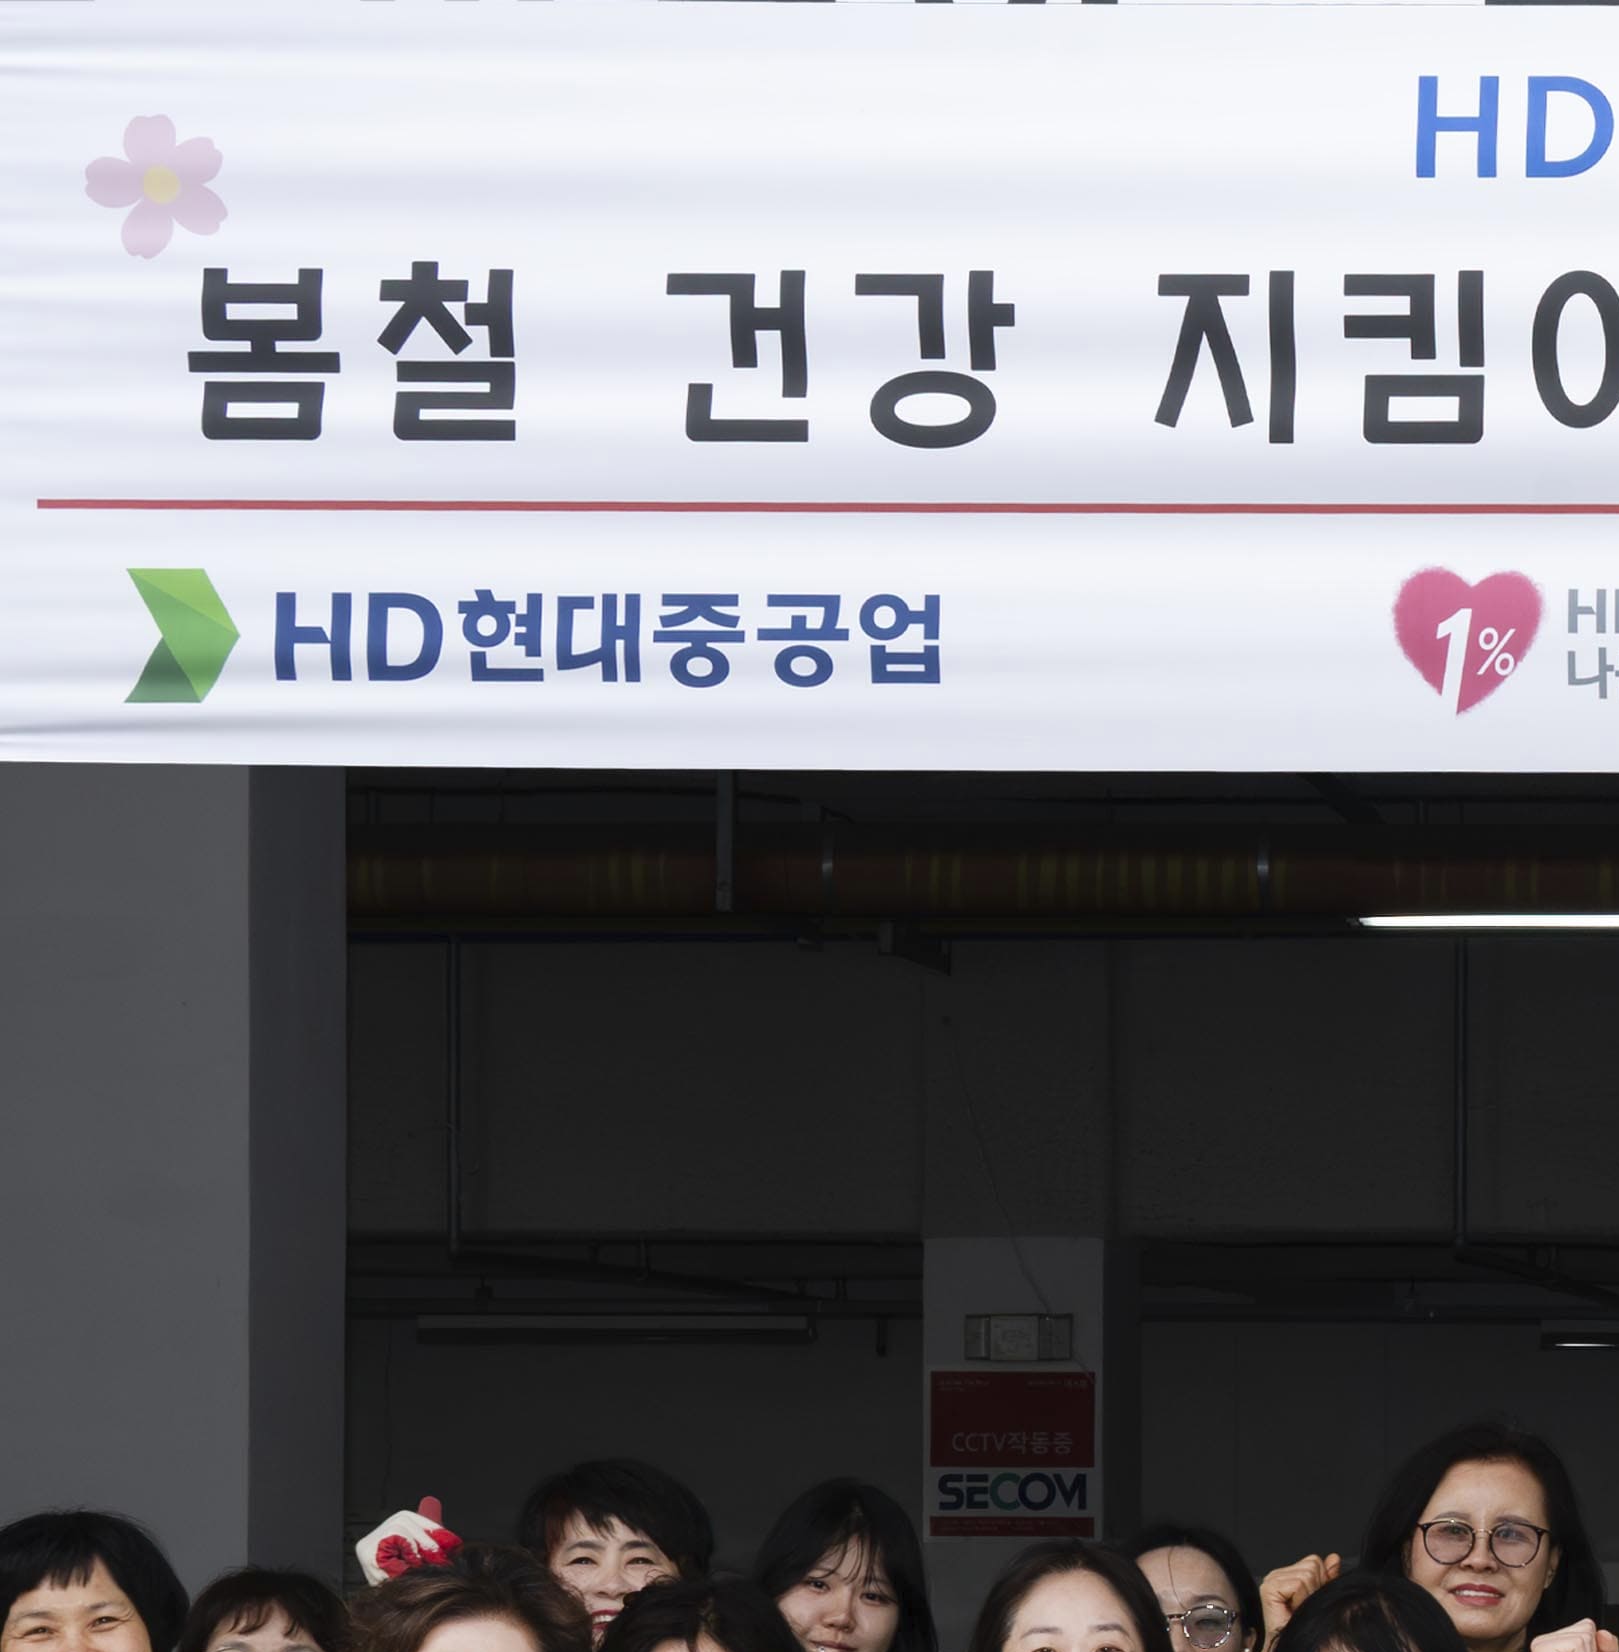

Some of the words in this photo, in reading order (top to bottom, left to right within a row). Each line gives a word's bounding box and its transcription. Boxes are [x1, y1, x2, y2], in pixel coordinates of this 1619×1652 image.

[187, 260, 517, 442] 봄철
[665, 269, 1016, 450] 건강
[274, 588, 941, 689] HD현대중공업
[952, 1432, 1074, 1455] CCTV작동중
[938, 1472, 1088, 1512] SECOM
